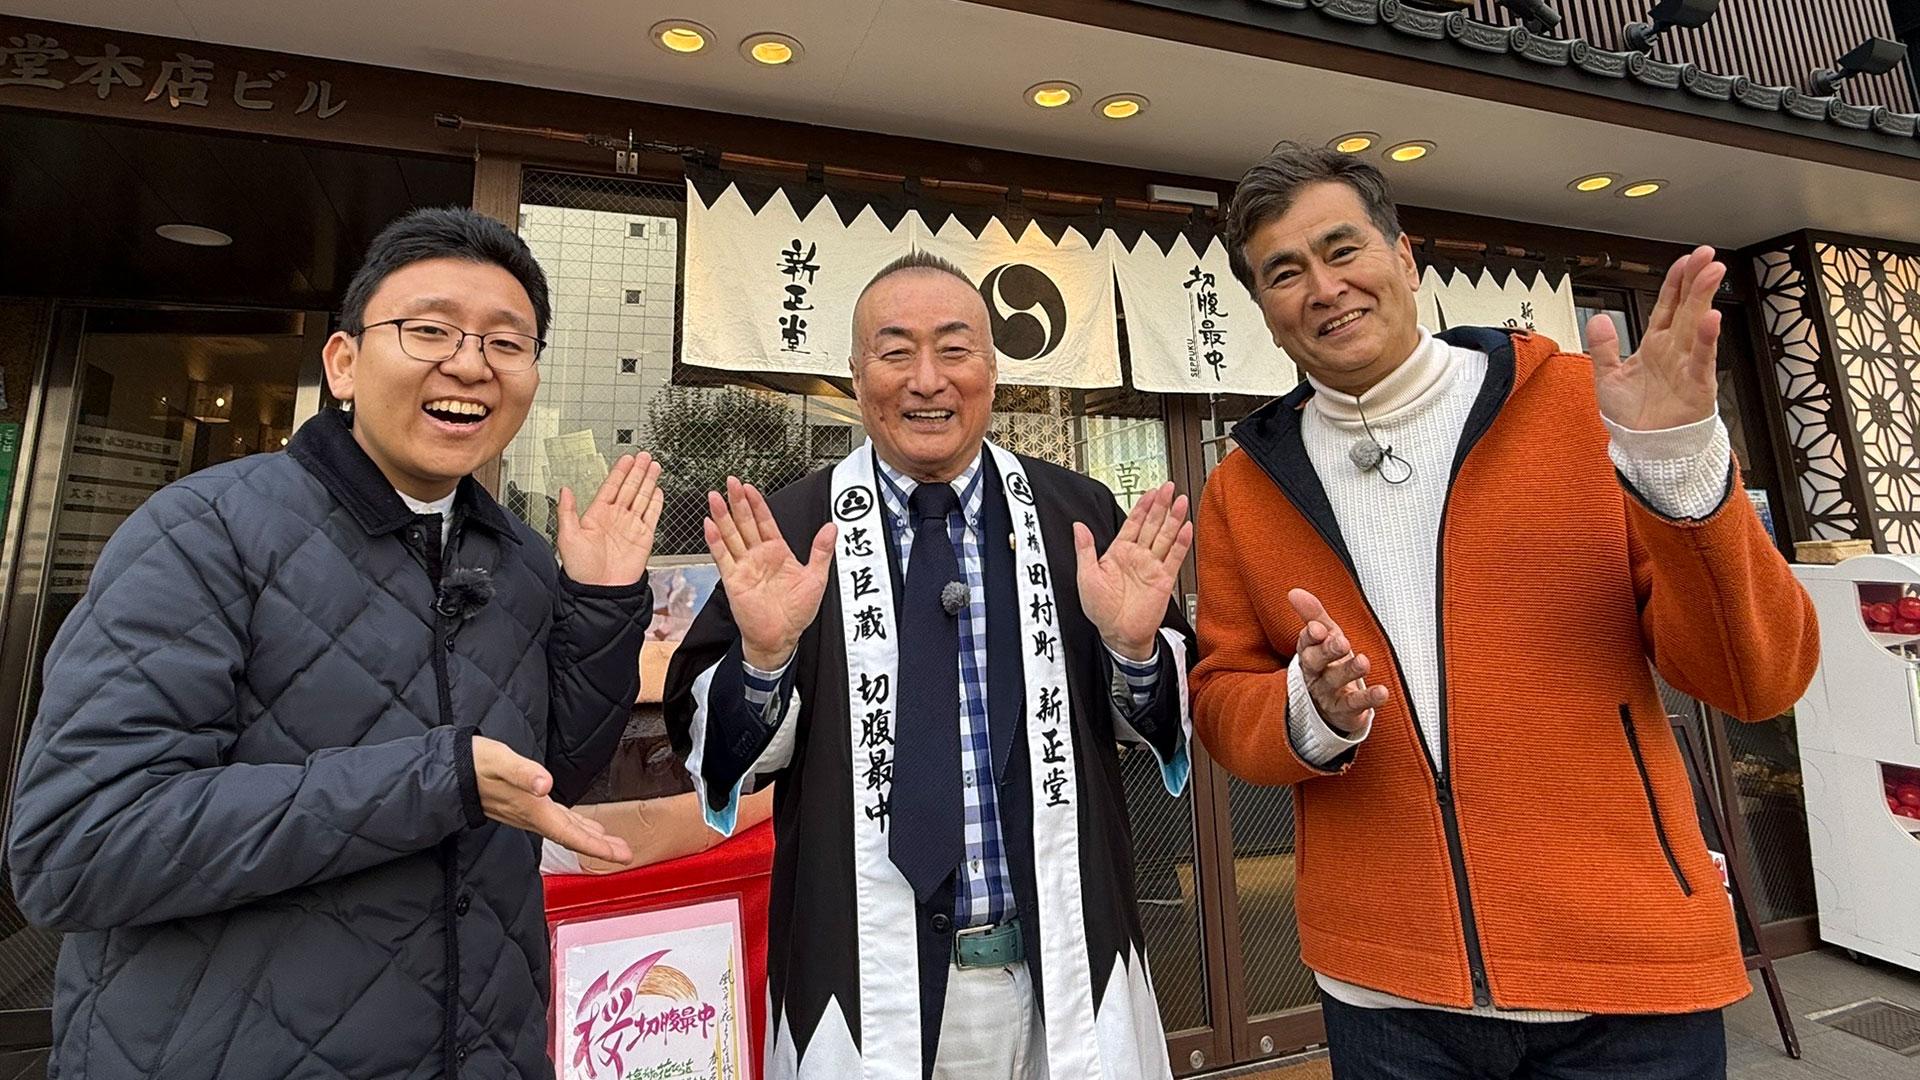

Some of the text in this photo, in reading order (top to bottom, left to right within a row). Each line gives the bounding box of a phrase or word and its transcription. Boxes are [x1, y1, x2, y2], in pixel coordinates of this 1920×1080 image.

[0, 32, 347, 120] 堂本店ビル
[776, 239, 820, 354] 新正堂
[1183, 265, 1229, 381] 切腹最中
[1186, 338, 1199, 377] SEPPUKU
[1026, 563, 1057, 663] 田村町
[844, 527, 895, 834] 忠臣蔵 切腹最中
[1035, 686, 1070, 807] 新正堂
[626, 1002, 715, 1052] 切腹最中
